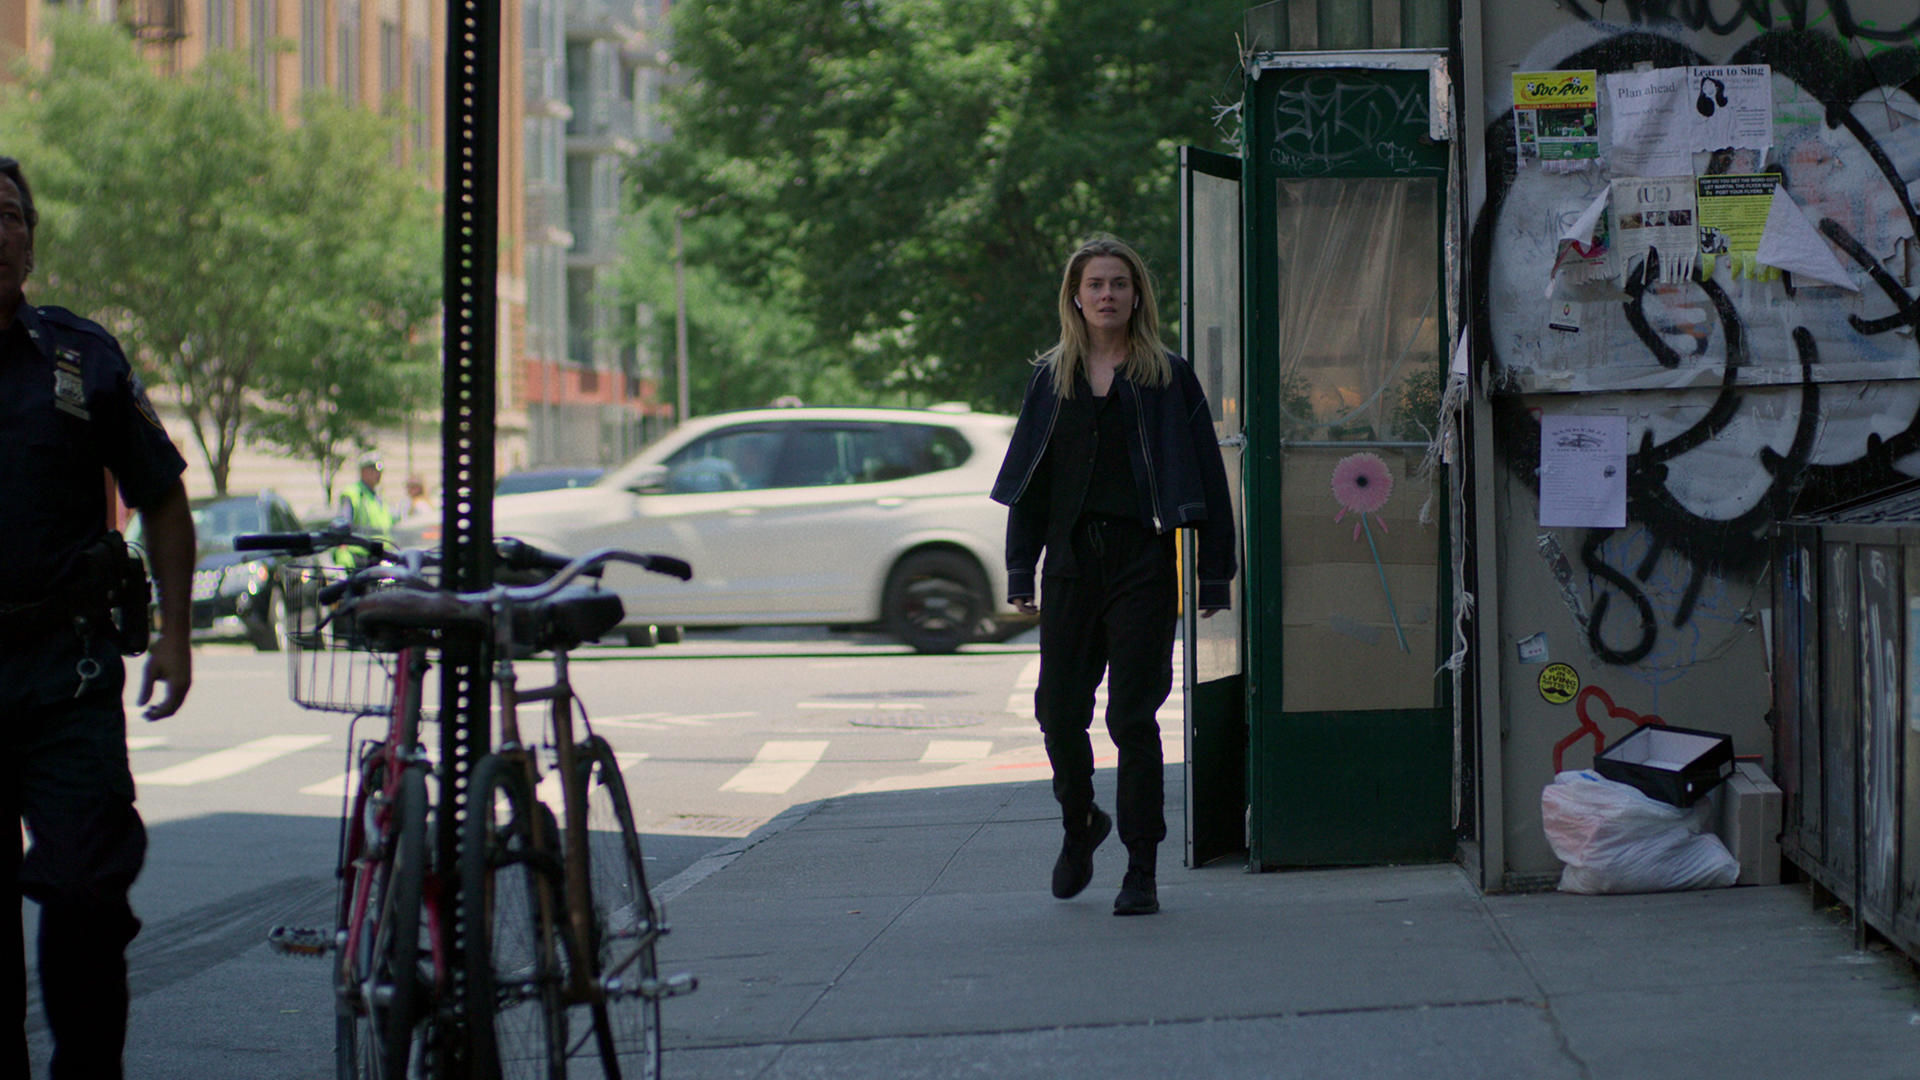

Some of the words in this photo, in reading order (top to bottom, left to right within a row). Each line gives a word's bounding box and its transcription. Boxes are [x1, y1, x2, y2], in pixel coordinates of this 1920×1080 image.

[1693, 68, 1723, 77] Learn
[1726, 67, 1737, 76] to
[1740, 66, 1764, 76] Sing
[1618, 87, 1642, 98] Plan
[1542, 674, 1577, 687] LIVING
